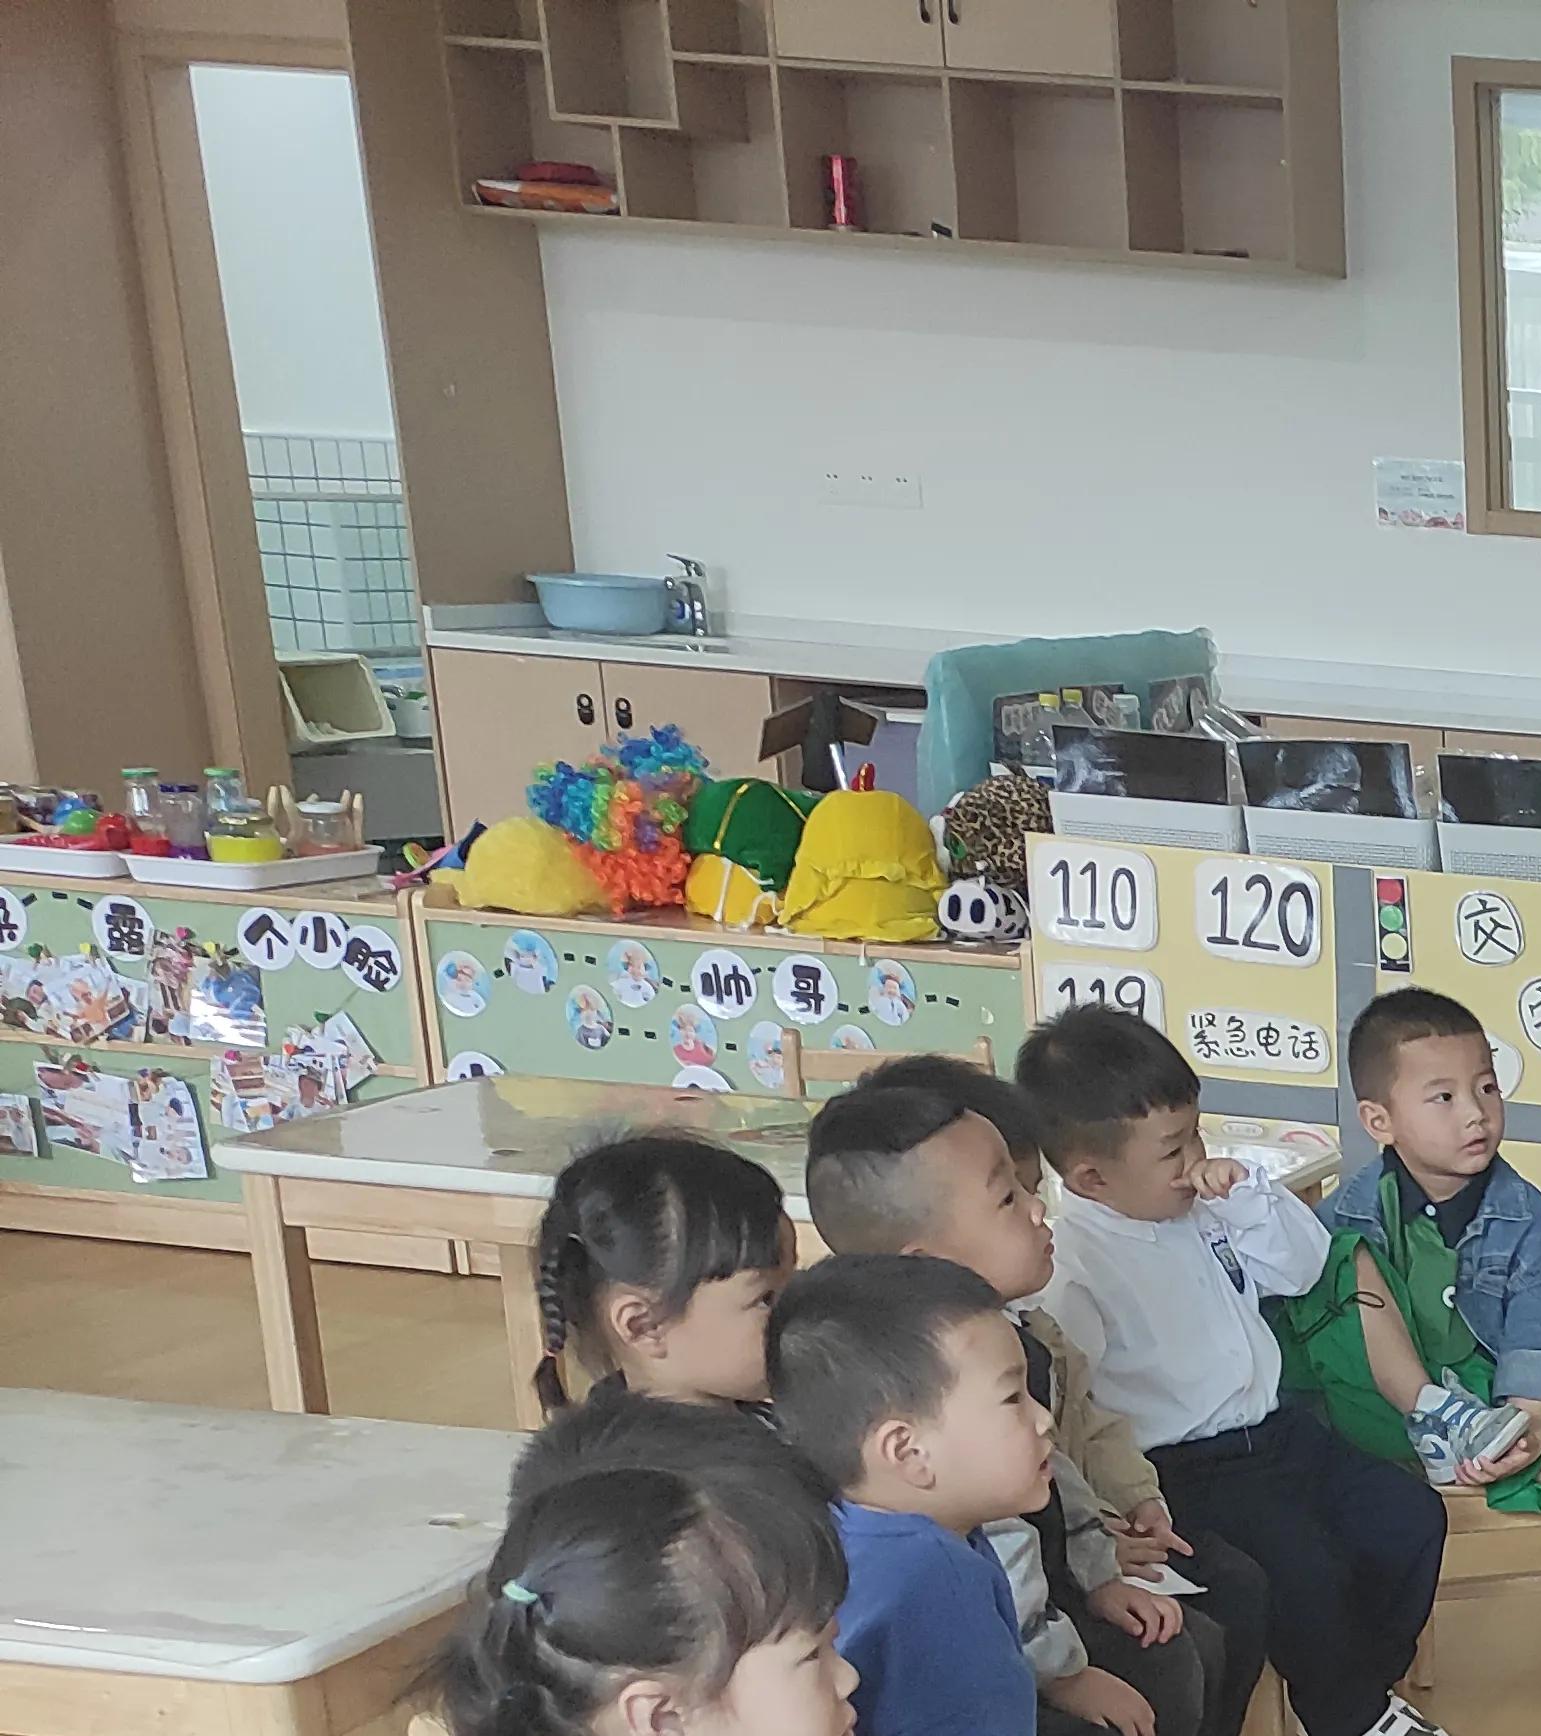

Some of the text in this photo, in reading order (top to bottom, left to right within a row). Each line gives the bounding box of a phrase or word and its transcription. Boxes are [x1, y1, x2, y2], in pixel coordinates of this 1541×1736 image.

[1049, 859, 1137, 931] 110
[1206, 873, 1314, 958] 120
[1190, 1013, 1320, 1060] 紧急电话
